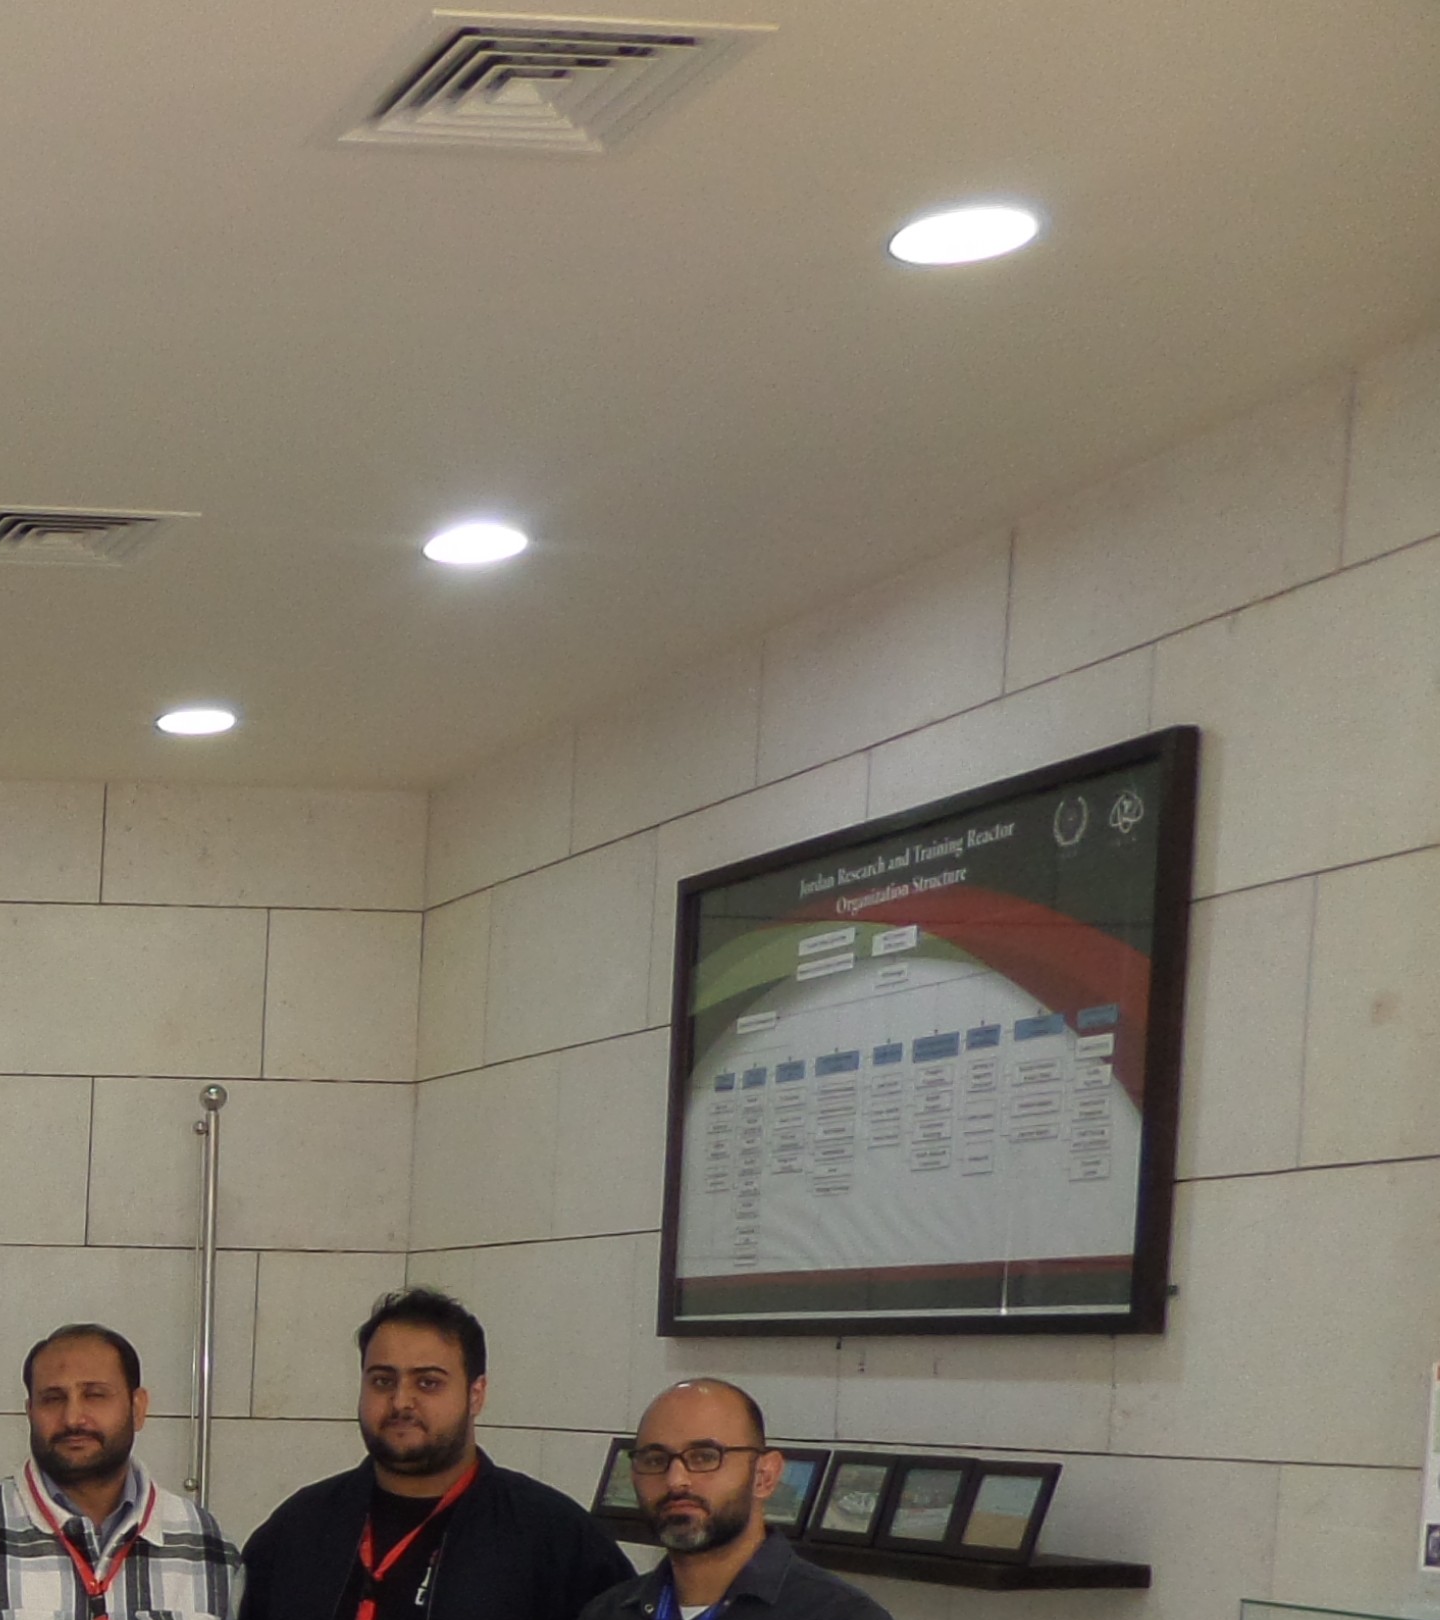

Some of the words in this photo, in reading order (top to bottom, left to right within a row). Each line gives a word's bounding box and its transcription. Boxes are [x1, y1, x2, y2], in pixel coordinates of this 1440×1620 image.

[799, 873, 835, 898] Jordan
[837, 856, 885, 885] Research
[888, 848, 910, 870] and
[914, 837, 963, 863] Training
[967, 822, 1015, 848] Reactor
[836, 883, 909, 916] Organization
[912, 867, 967, 893] Structure
